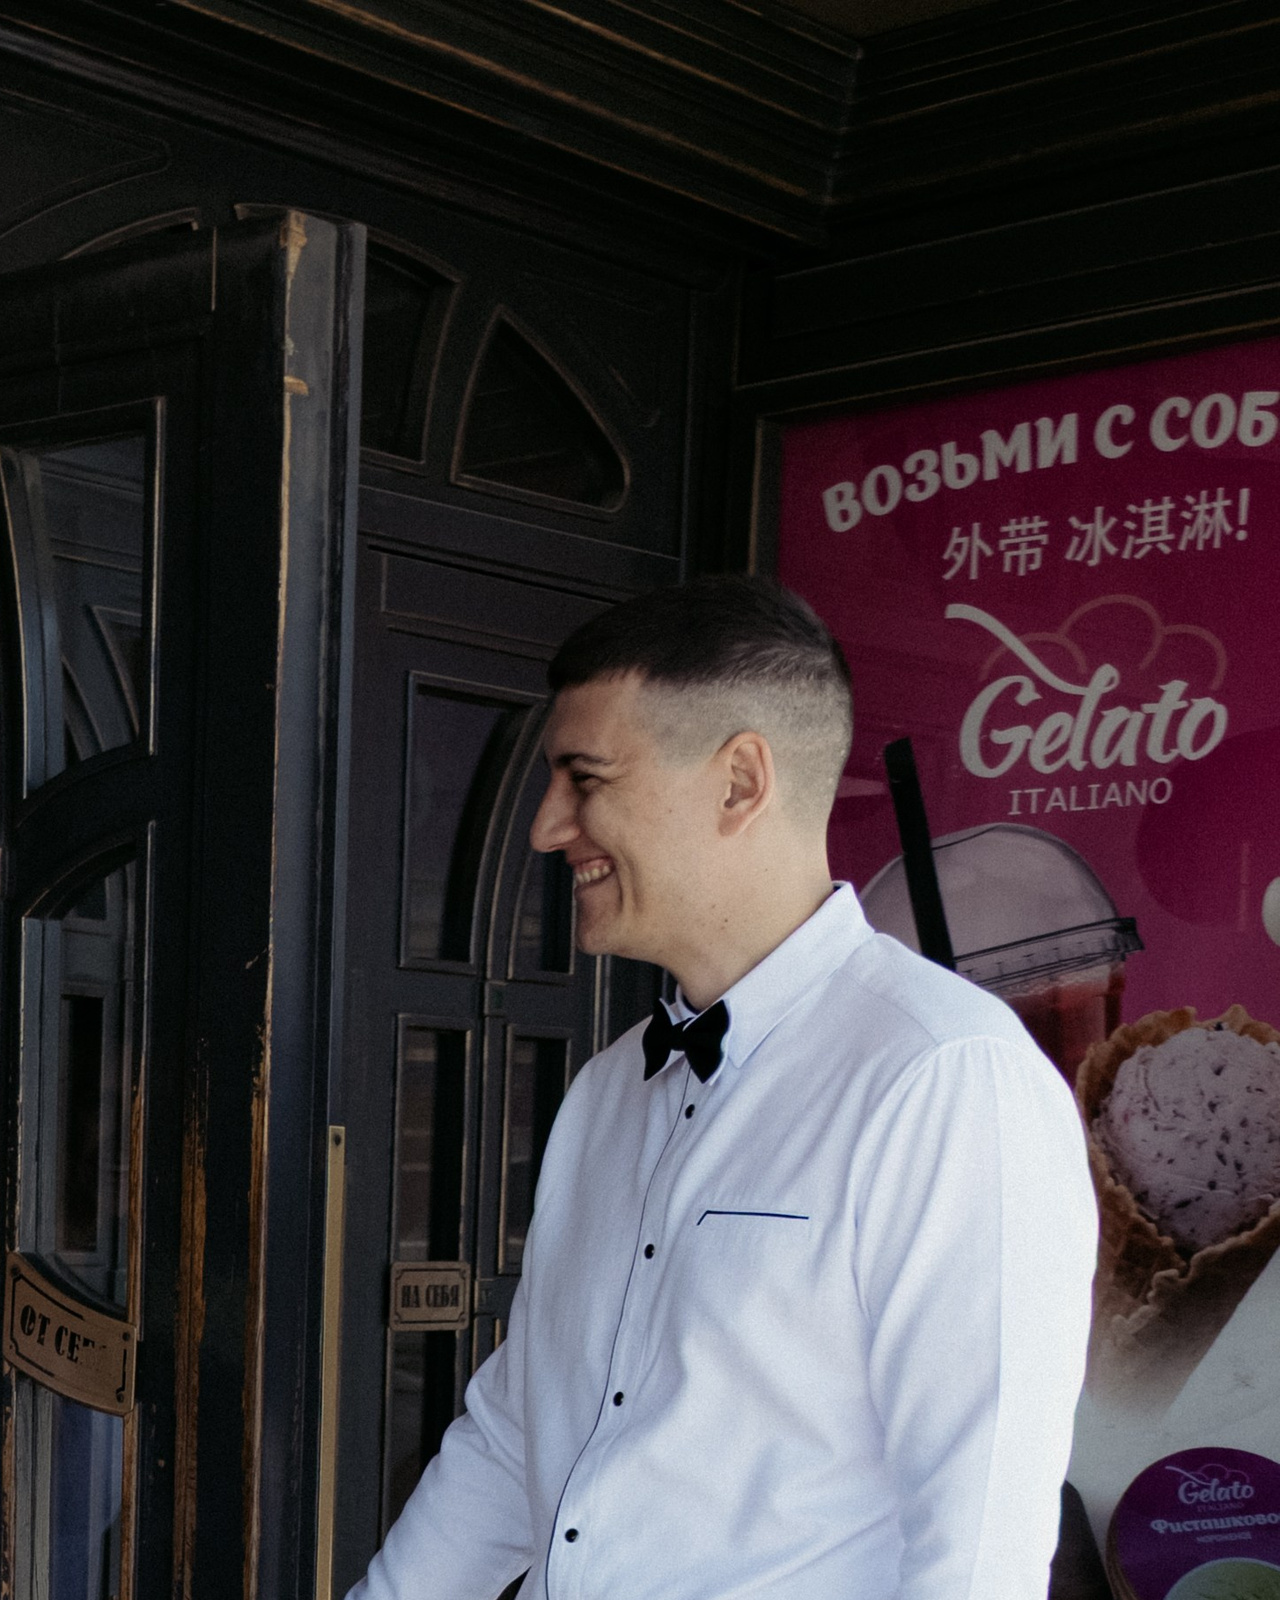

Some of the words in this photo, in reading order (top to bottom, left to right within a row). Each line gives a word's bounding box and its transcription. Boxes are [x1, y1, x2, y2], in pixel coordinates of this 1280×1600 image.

[822, 412, 1079, 533] ВОЗЬМИ
[1093, 403, 1136, 459] С
[1149, 390, 1280, 452] СОБ
[941, 515, 1050, 581] 外带
[1064, 487, 1252, 567] 冰淇淋!
[945, 603, 1229, 778] Gelato
[1007, 777, 1174, 816] ITALIANO
[401, 1284, 421, 1309] НА
[425, 1284, 460, 1308] СЕБЯ
[20, 1304, 51, 1347] ОТ
[54, 1324, 107, 1364] СЕ
[1165, 1465, 1255, 1505] Gelato
[1150, 1513, 1280, 1534] Фисташково
